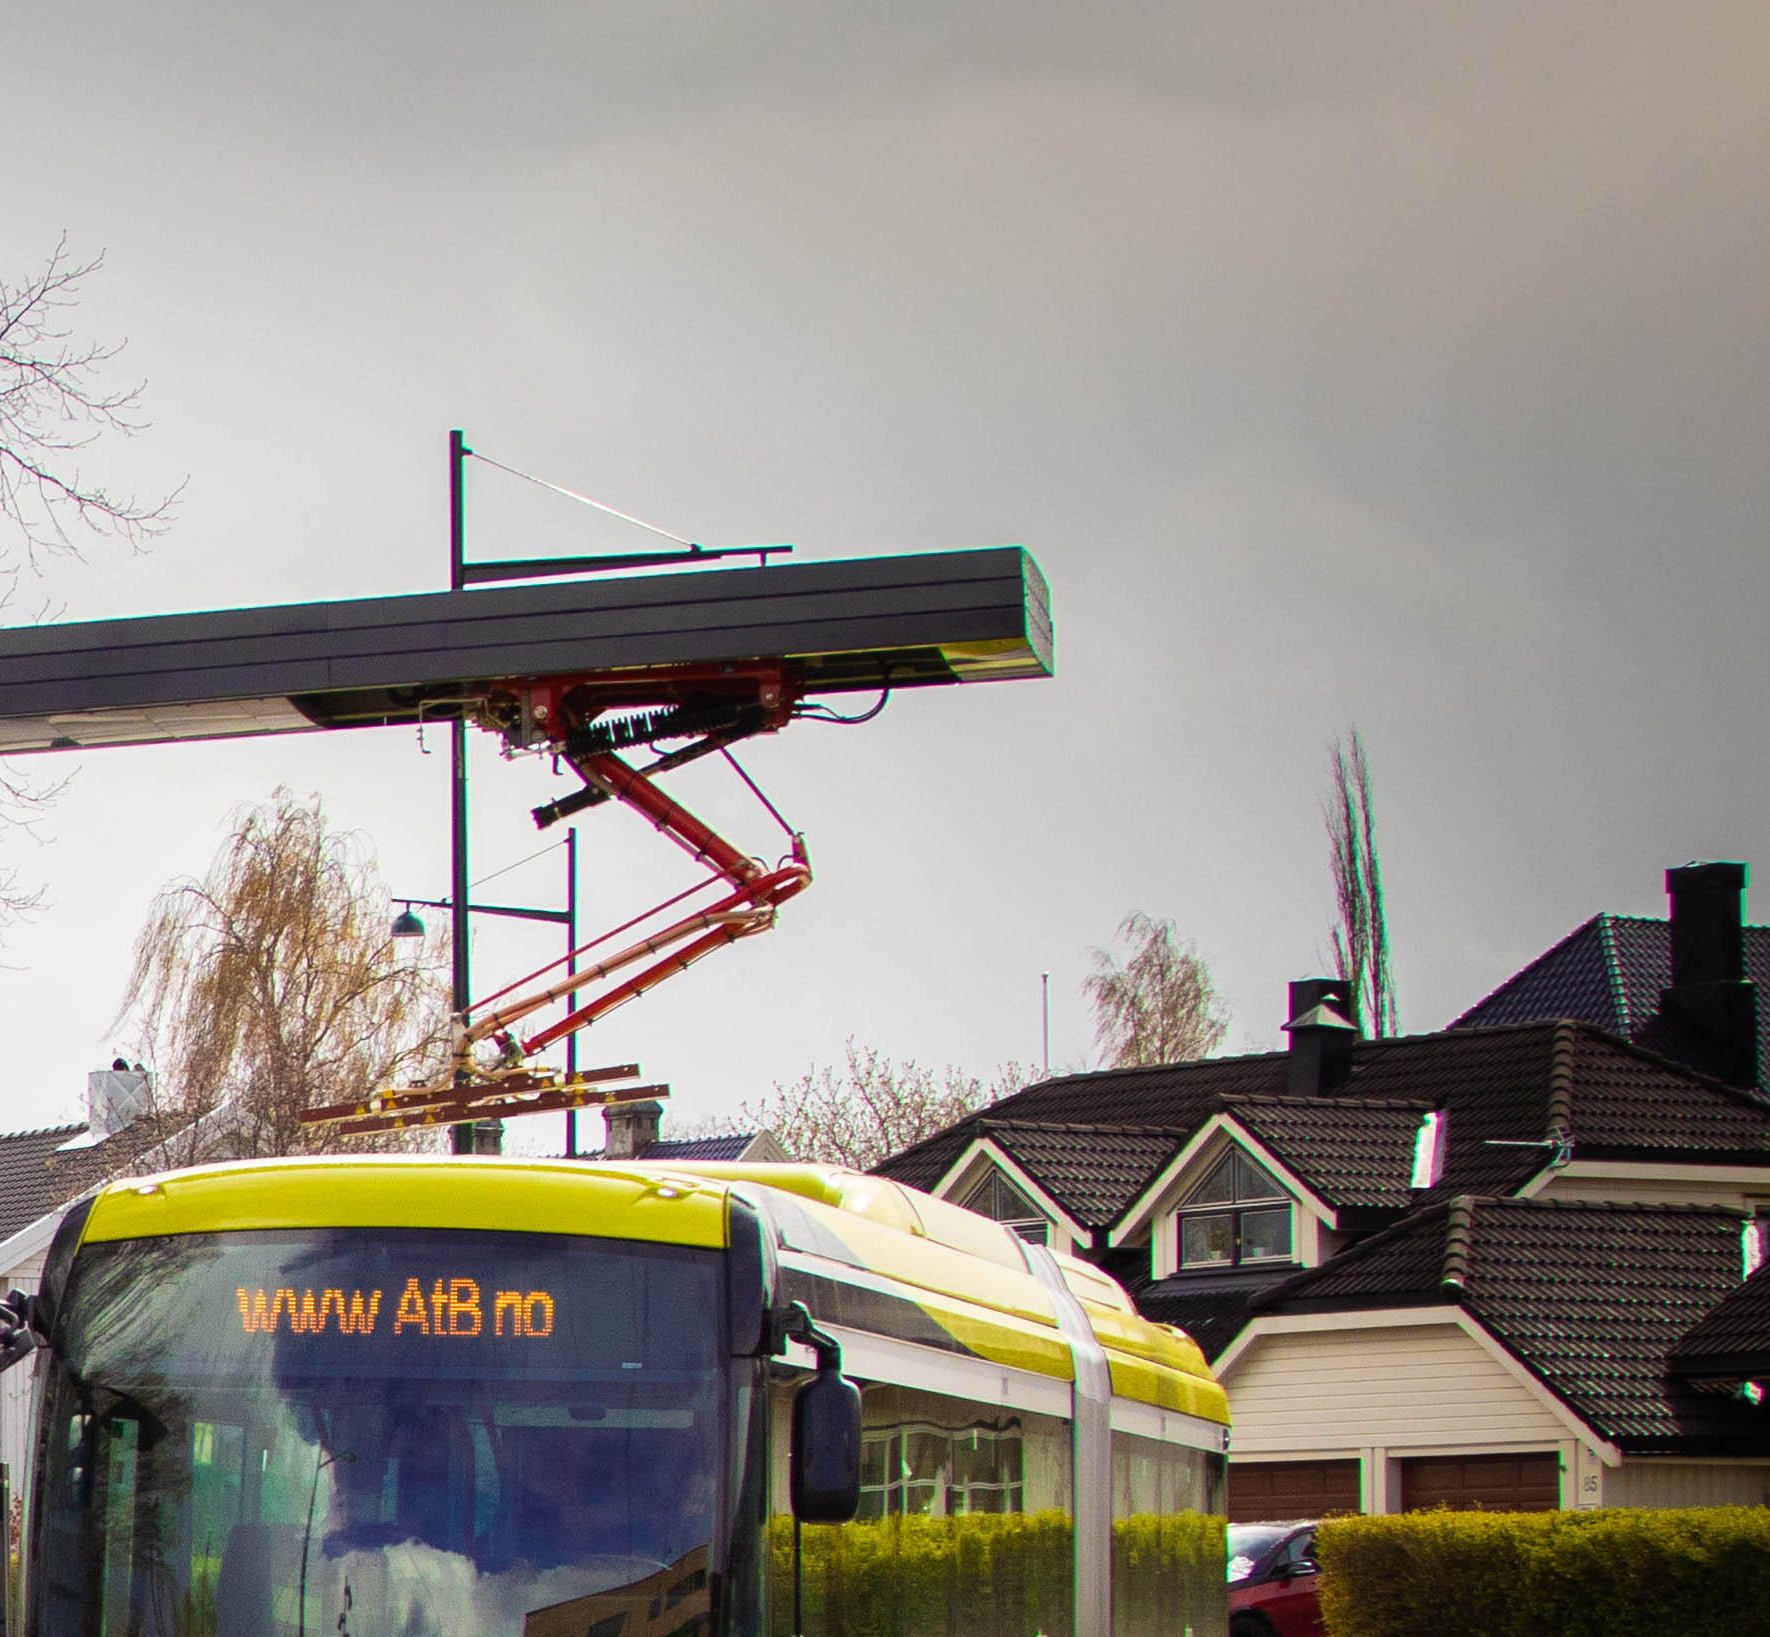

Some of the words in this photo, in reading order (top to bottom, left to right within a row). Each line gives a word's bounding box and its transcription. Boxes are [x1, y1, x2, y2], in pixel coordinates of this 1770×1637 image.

[236, 1288, 381, 1334] www
[394, 1278, 482, 1336] AtB
[494, 1290, 554, 1336] no
